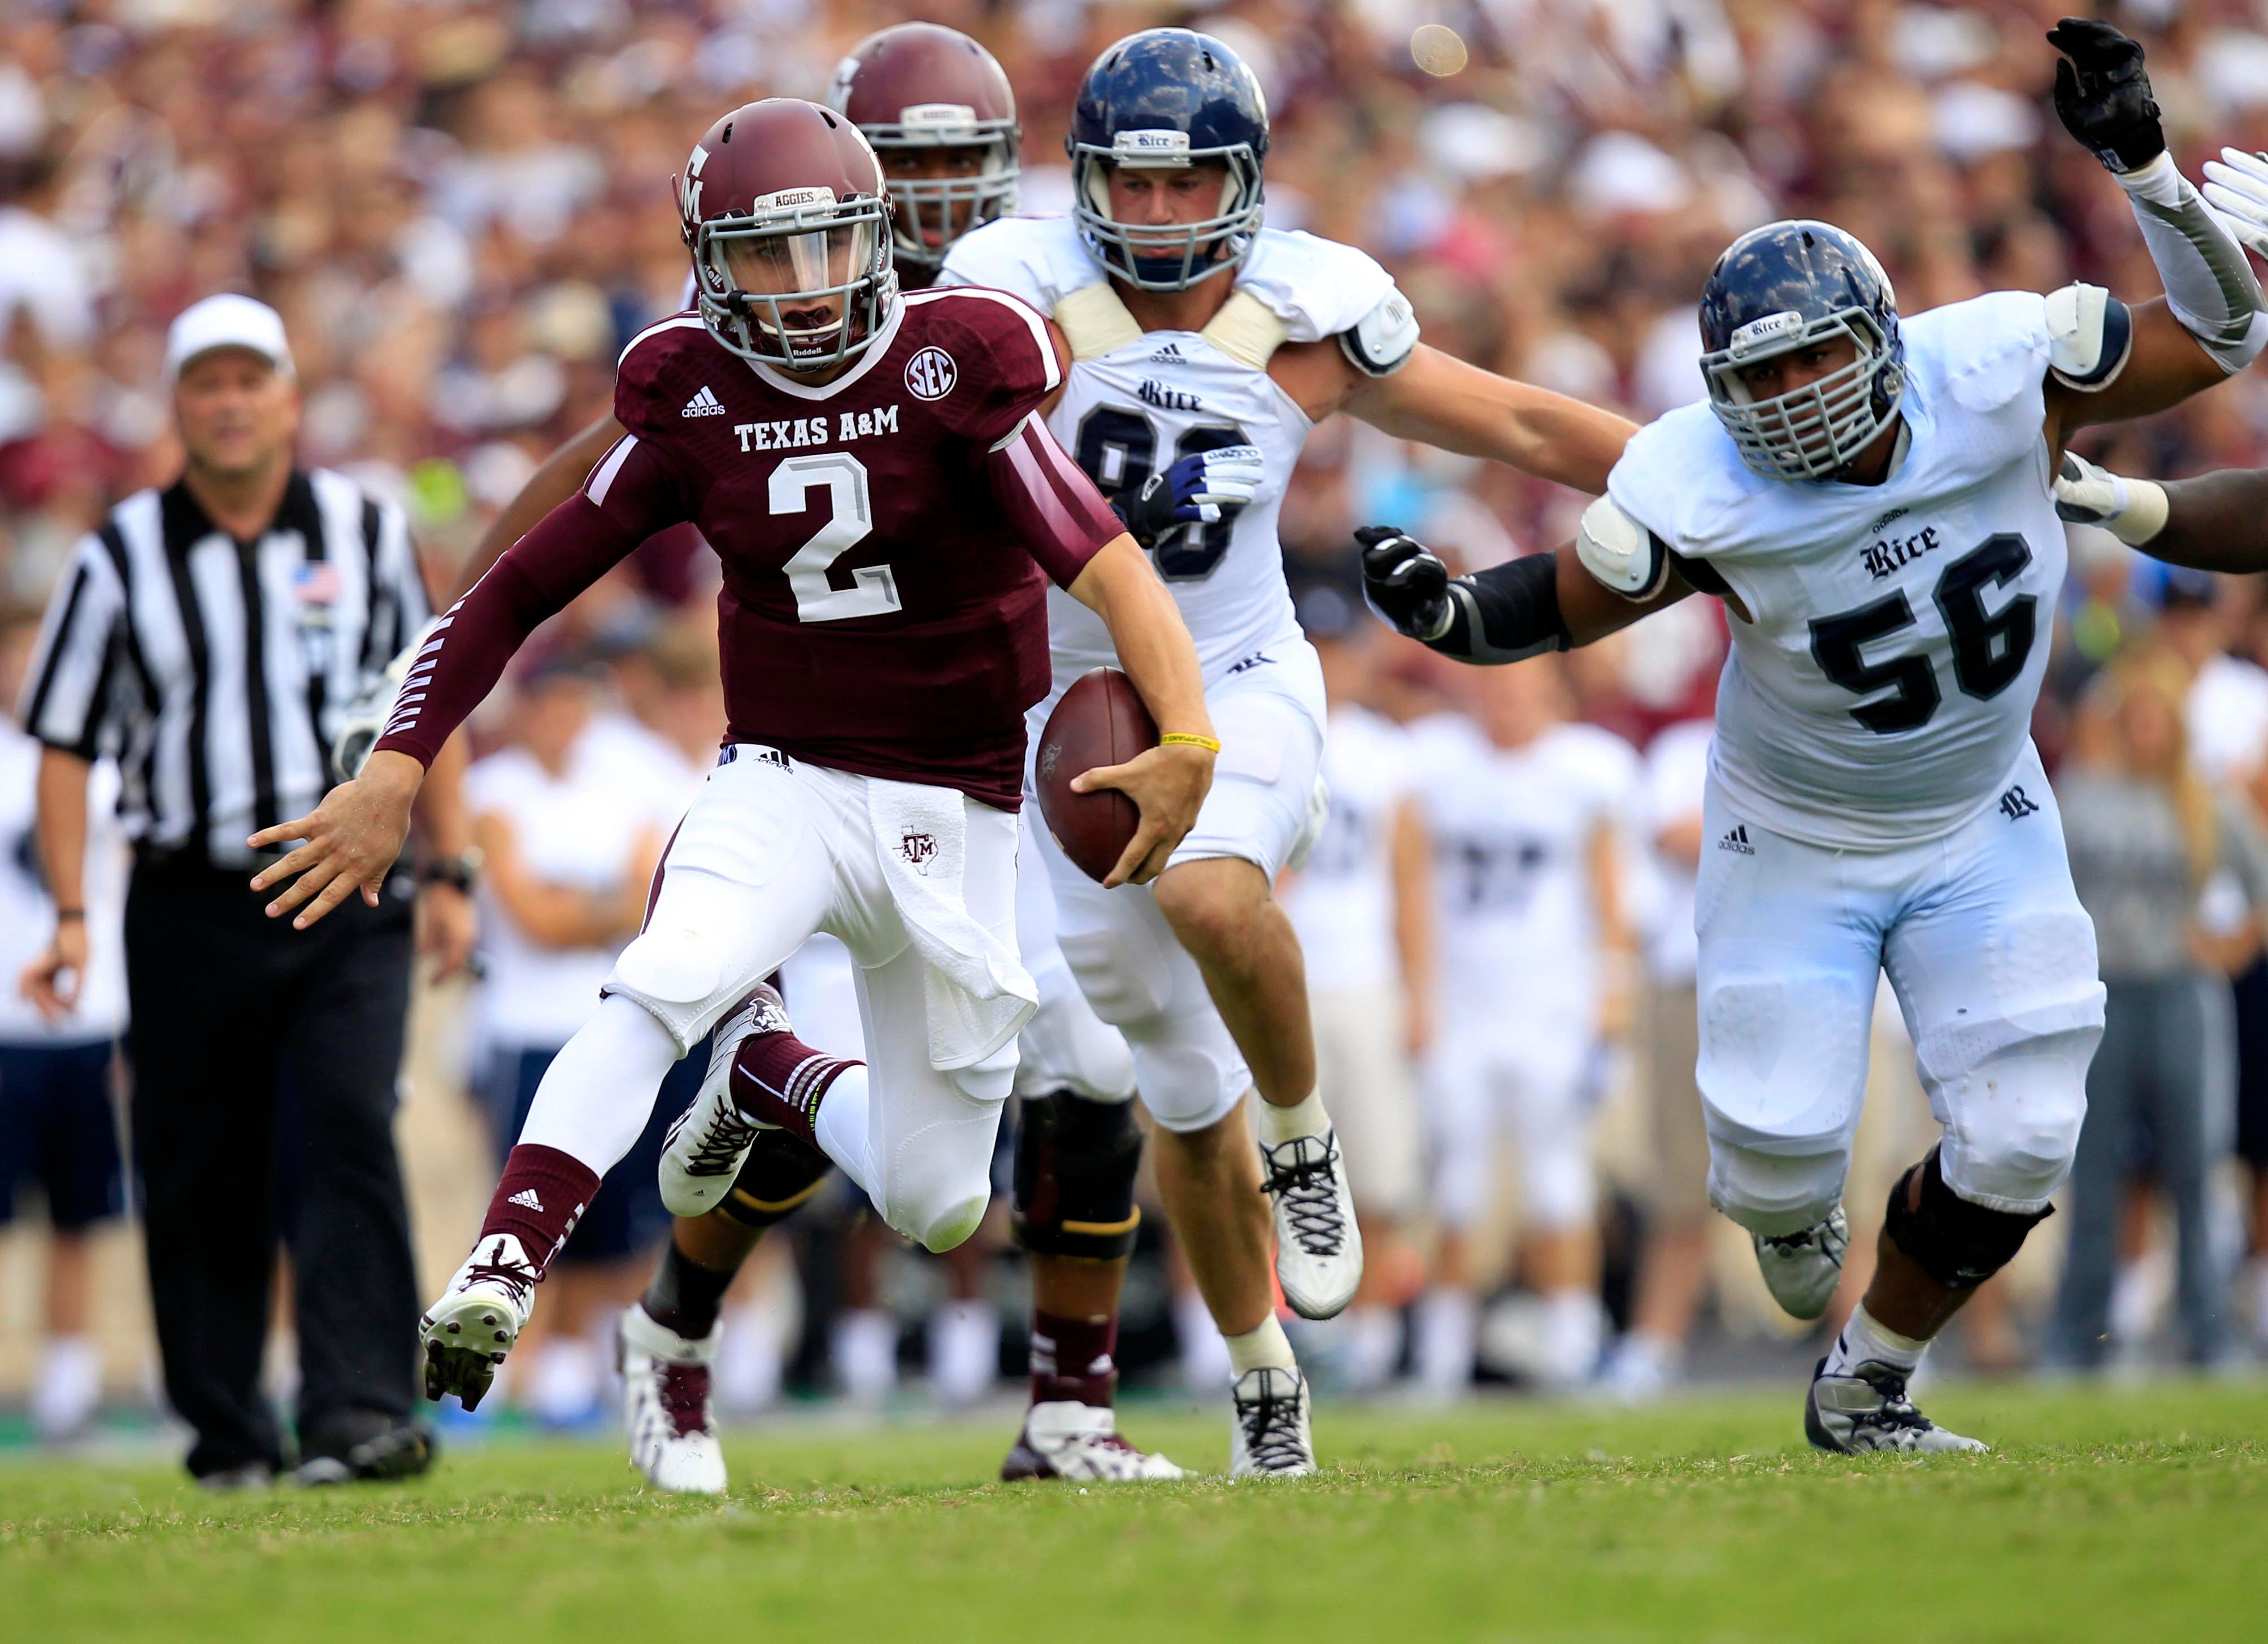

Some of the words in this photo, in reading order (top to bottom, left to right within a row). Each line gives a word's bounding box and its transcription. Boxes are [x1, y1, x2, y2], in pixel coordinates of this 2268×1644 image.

[1138, 133, 1170, 146] Rice
[775, 192, 815, 207] AGGIES
[1752, 320, 1781, 336] Rice
[909, 351, 953, 397] SEC
[681, 403, 726, 418] adidas
[1137, 376, 1202, 412] Rice
[734, 416, 828, 453] TEXAS
[838, 405, 899, 441] A&M
[768, 451, 902, 623] 2
[1859, 525, 1940, 581] Rice
[1808, 532, 2038, 735] 56
[1999, 784, 2039, 823] R
[1718, 839, 1755, 855] adidas
[507, 1196, 544, 1212] adidas
